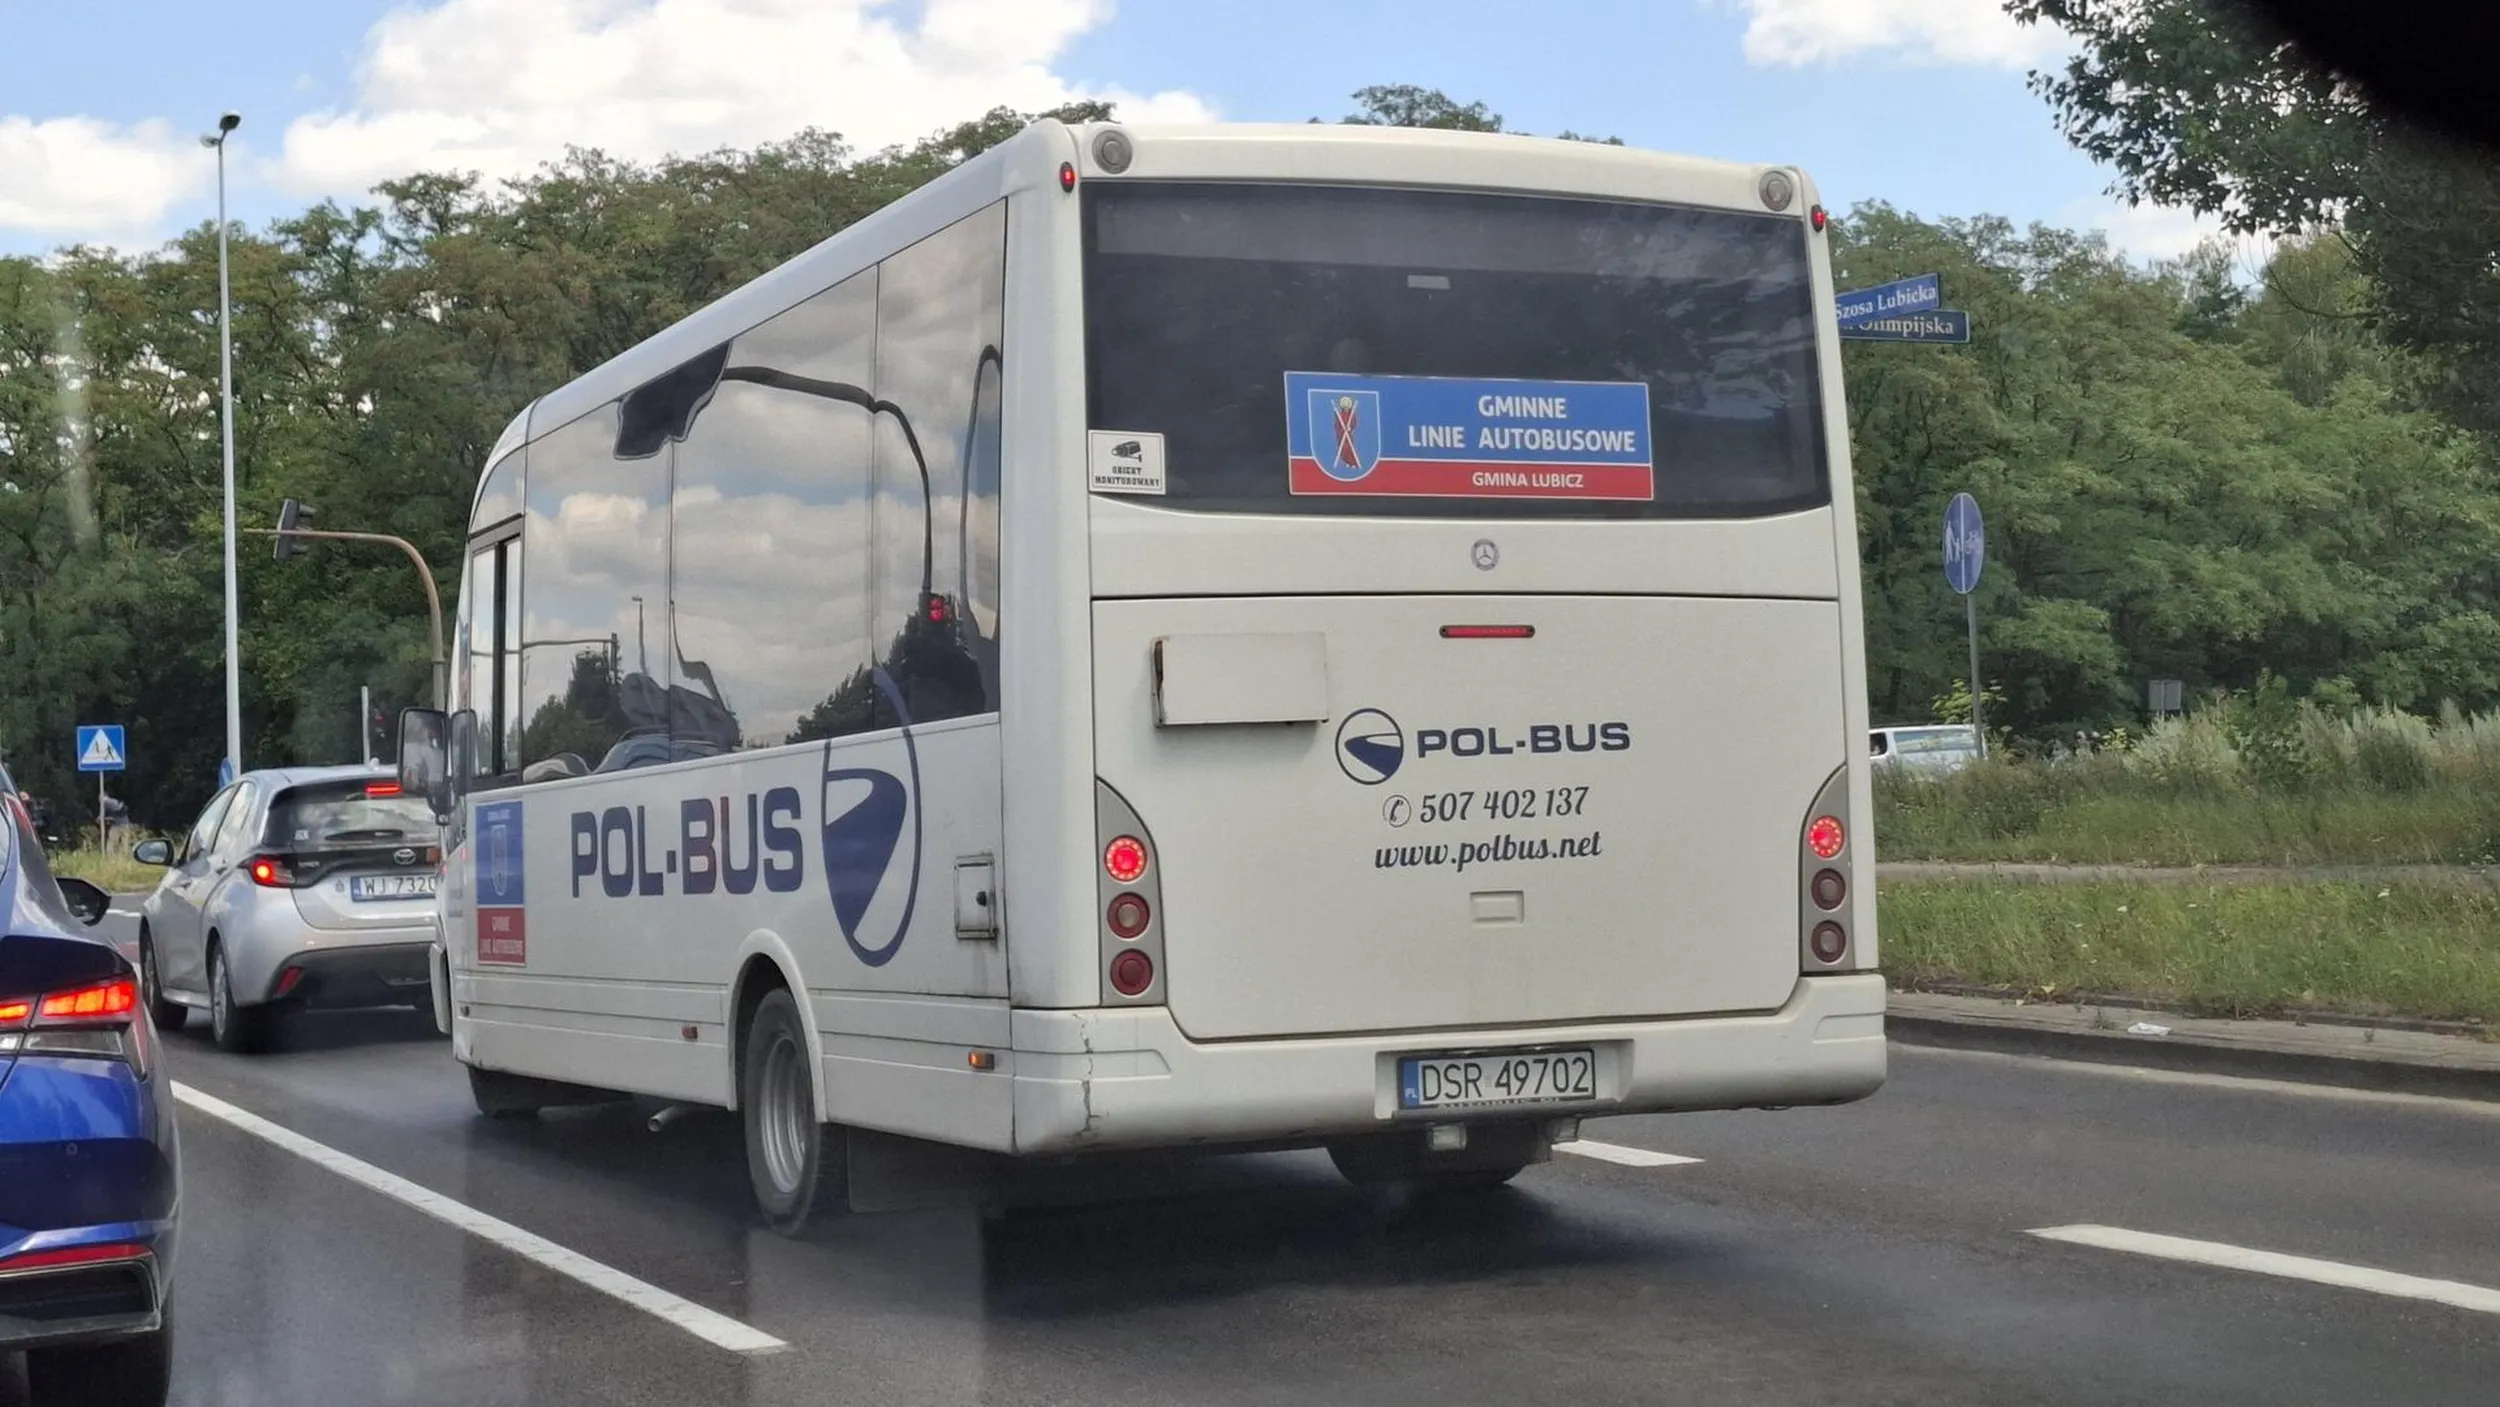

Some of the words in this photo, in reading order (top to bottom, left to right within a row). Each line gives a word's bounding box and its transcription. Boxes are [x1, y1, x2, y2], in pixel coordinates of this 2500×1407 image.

[1835, 302, 1873, 320] Szosa
[1878, 285, 1937, 311] Lubicka
[1478, 395, 1567, 419] GMINNE
[1408, 425, 1466, 448] LINIE
[1478, 426, 1637, 453] AUTOBUSOWE
[1472, 472, 1528, 487] GMINA
[1532, 472, 1584, 488] LUBICZ
[1416, 722, 1631, 758] POL-BUS
[1420, 792, 1475, 824] 507
[1483, 789, 1536, 820] 402
[1545, 787, 1589, 817] 137
[571, 786, 804, 898] POL-BUS
[1375, 831, 1604, 872] www.polbus.net
[1421, 1062, 1482, 1101] DSR
[1494, 1056, 1590, 1096] 49702
